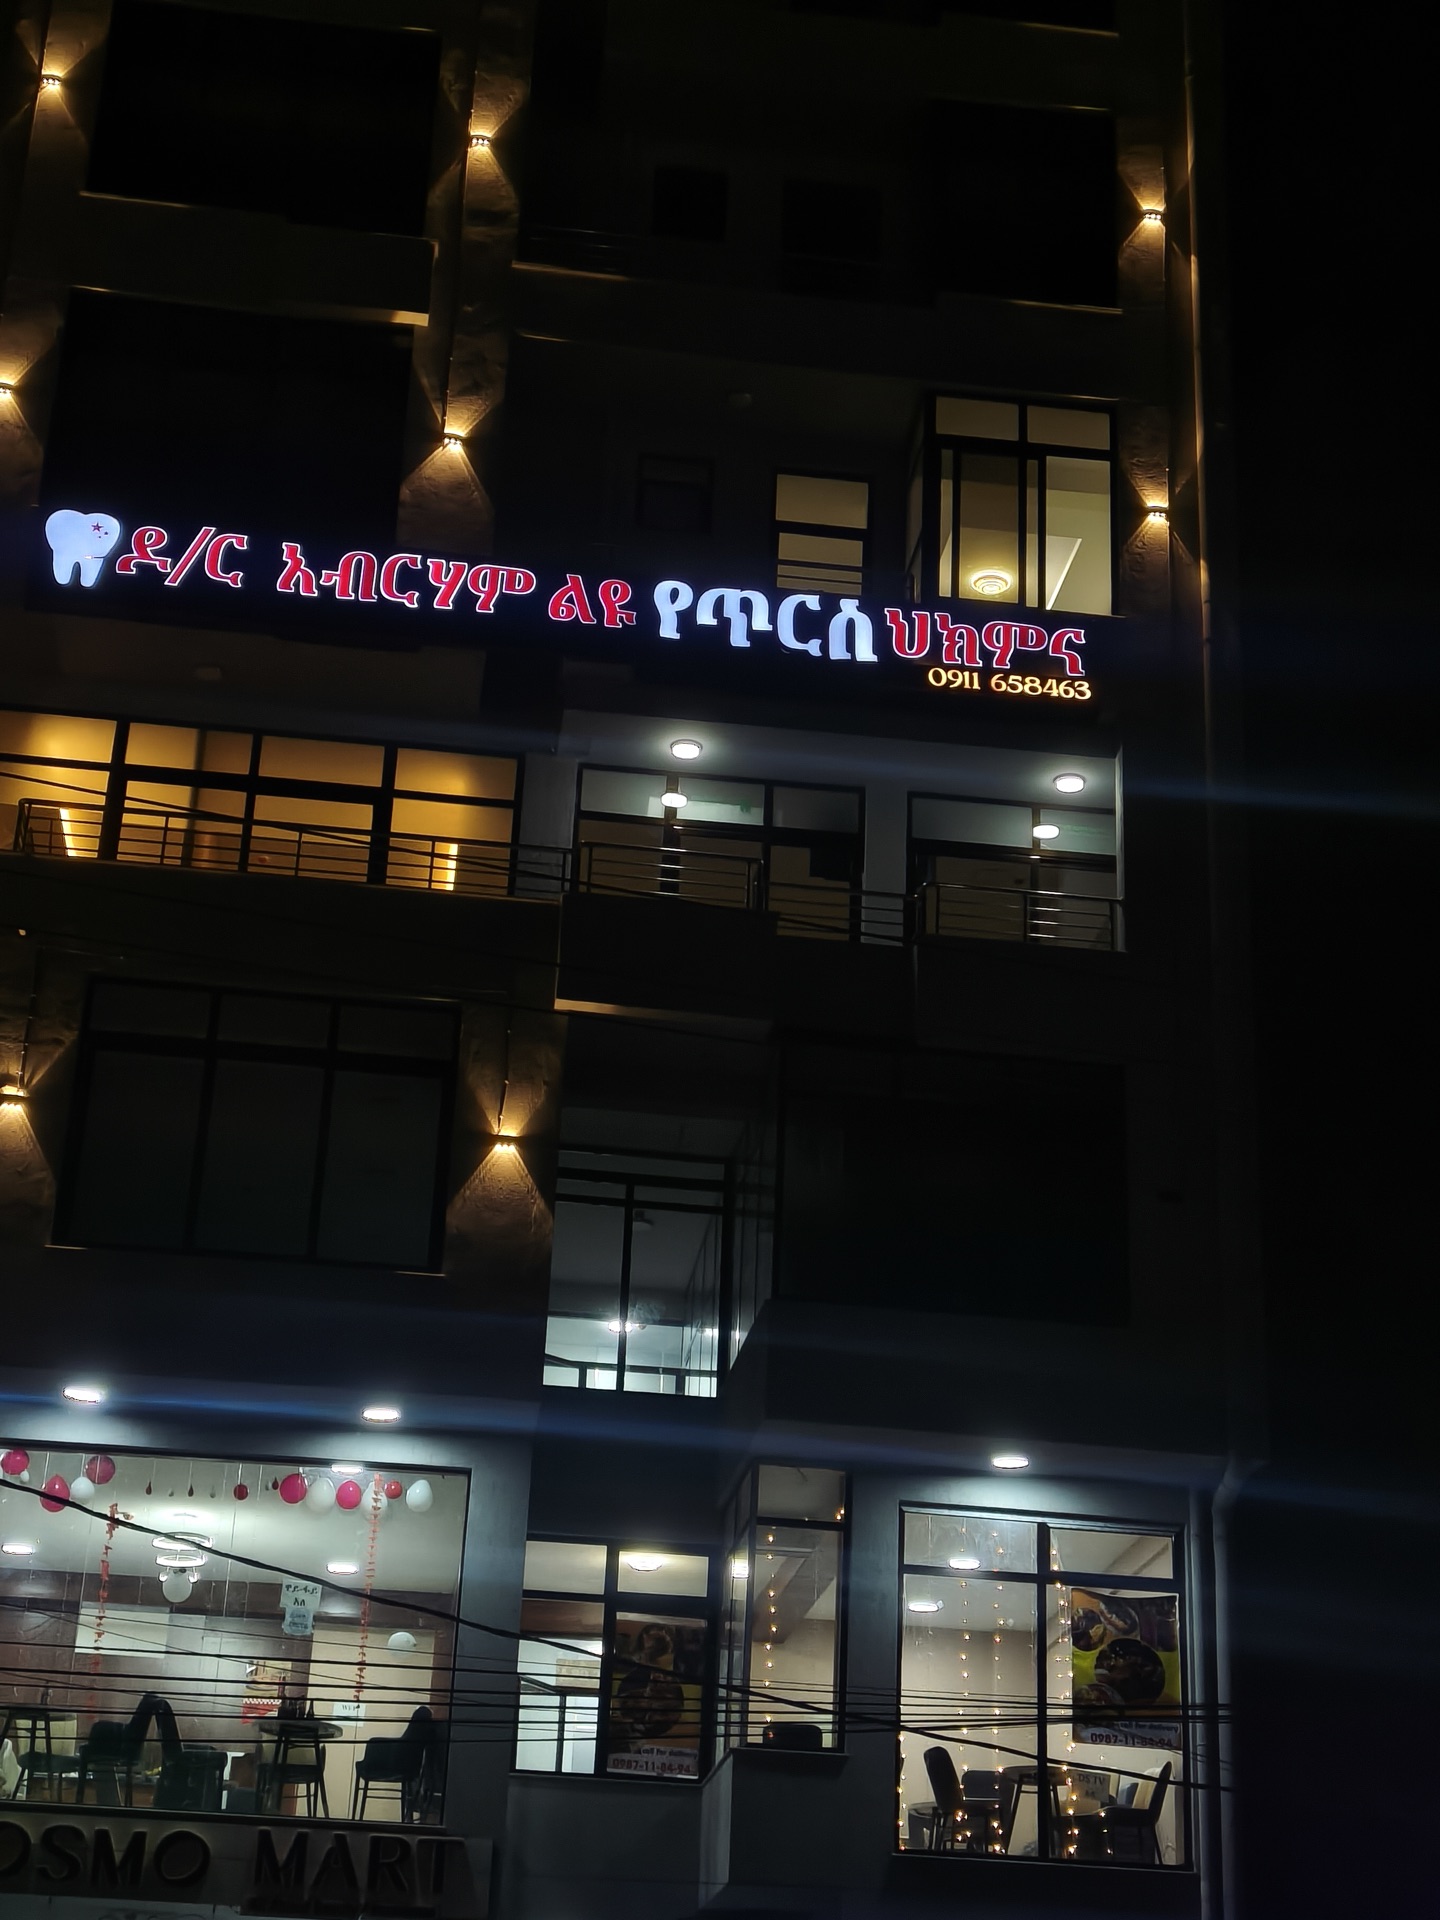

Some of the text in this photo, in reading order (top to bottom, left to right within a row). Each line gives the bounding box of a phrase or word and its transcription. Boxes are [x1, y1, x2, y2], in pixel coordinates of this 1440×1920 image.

[116, 525, 1086, 676] ዶ/ር አብርሃም ልዩ የጥርስ ህክምና
[927, 667, 1092, 700] 0911 658463
[254, 1829, 465, 1894] MART
